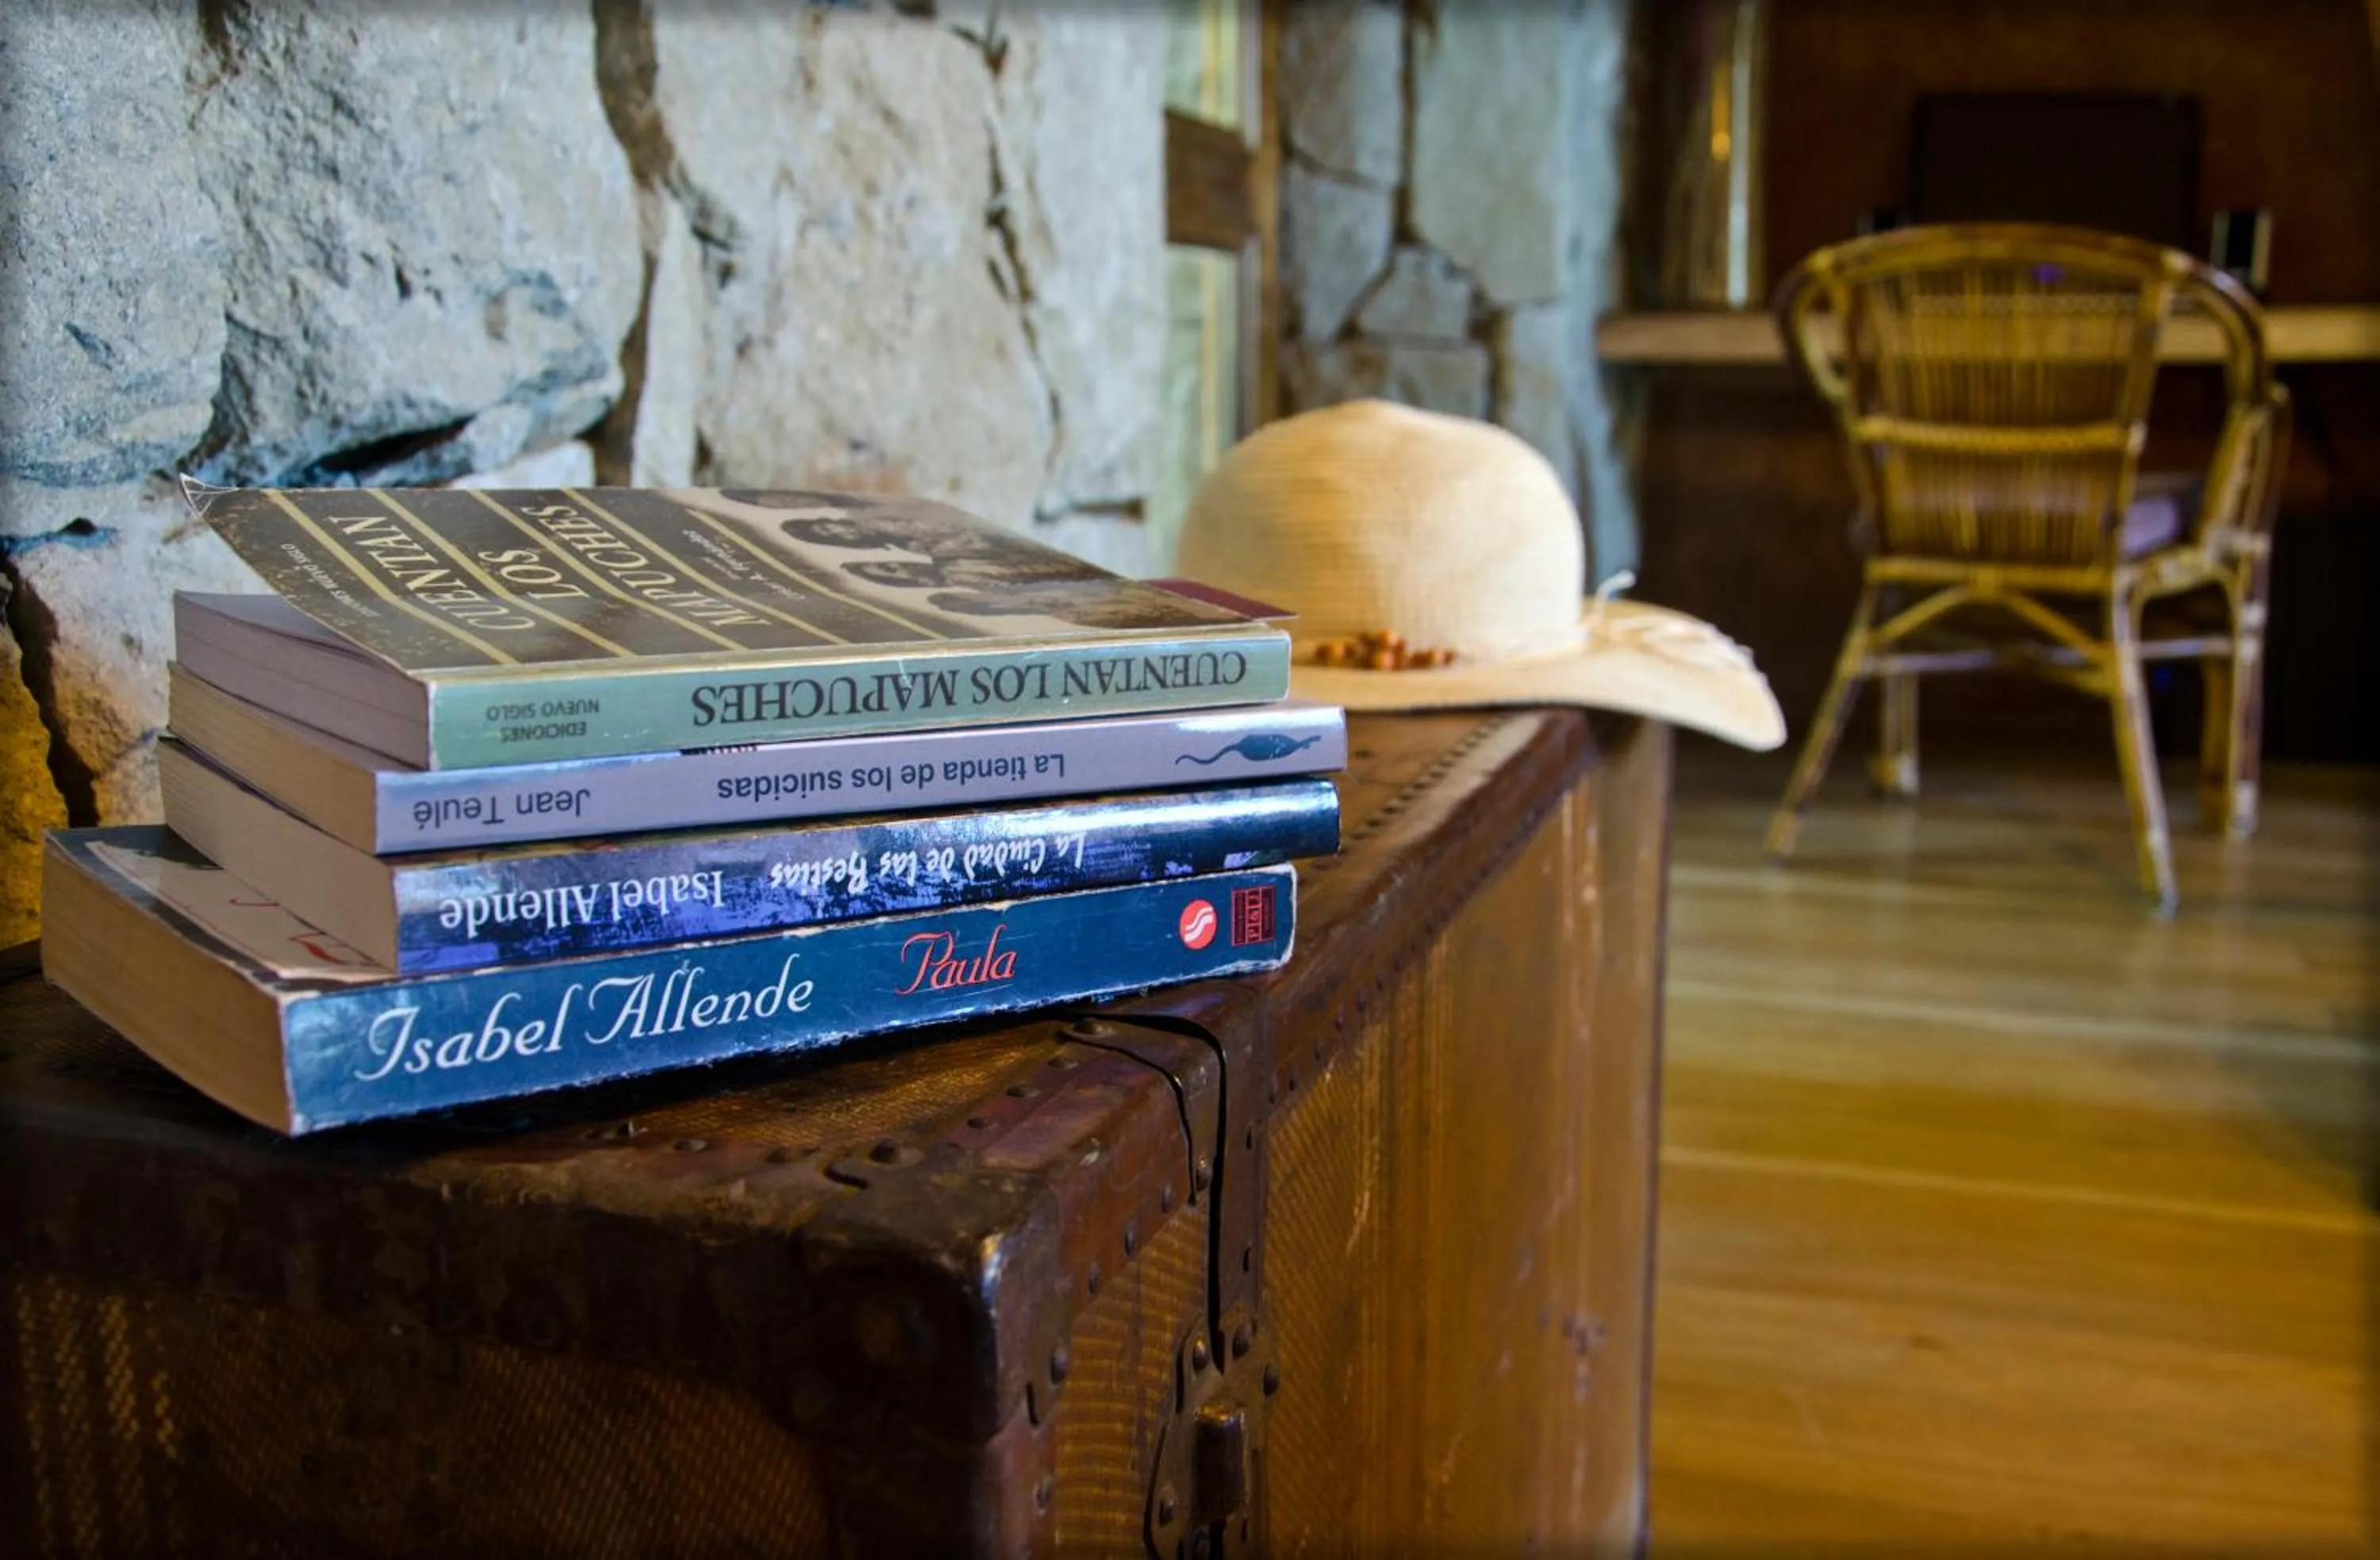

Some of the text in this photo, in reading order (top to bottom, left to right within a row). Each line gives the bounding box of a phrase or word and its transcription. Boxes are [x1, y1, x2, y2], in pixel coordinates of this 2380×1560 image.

[326, 513, 536, 630] CUENTAN
[478, 549, 591, 601] LOS
[521, 505, 773, 627] MAPUCHES
[486, 697, 600, 721] NUEVO SIGLO
[691, 650, 1247, 728] CUENTAN LOS MAPUCHES
[501, 721, 587, 743] EDICIONES
[413, 789, 591, 831] Jean Teulé
[717, 752, 1065, 803] La tienda de los suicidas
[770, 831, 1088, 895] La Ciudad de las Bestias
[439, 870, 724, 939] Isabel Allende
[894, 924, 1017, 996] Paula
[354, 952, 815, 1082] Isabel Allende
